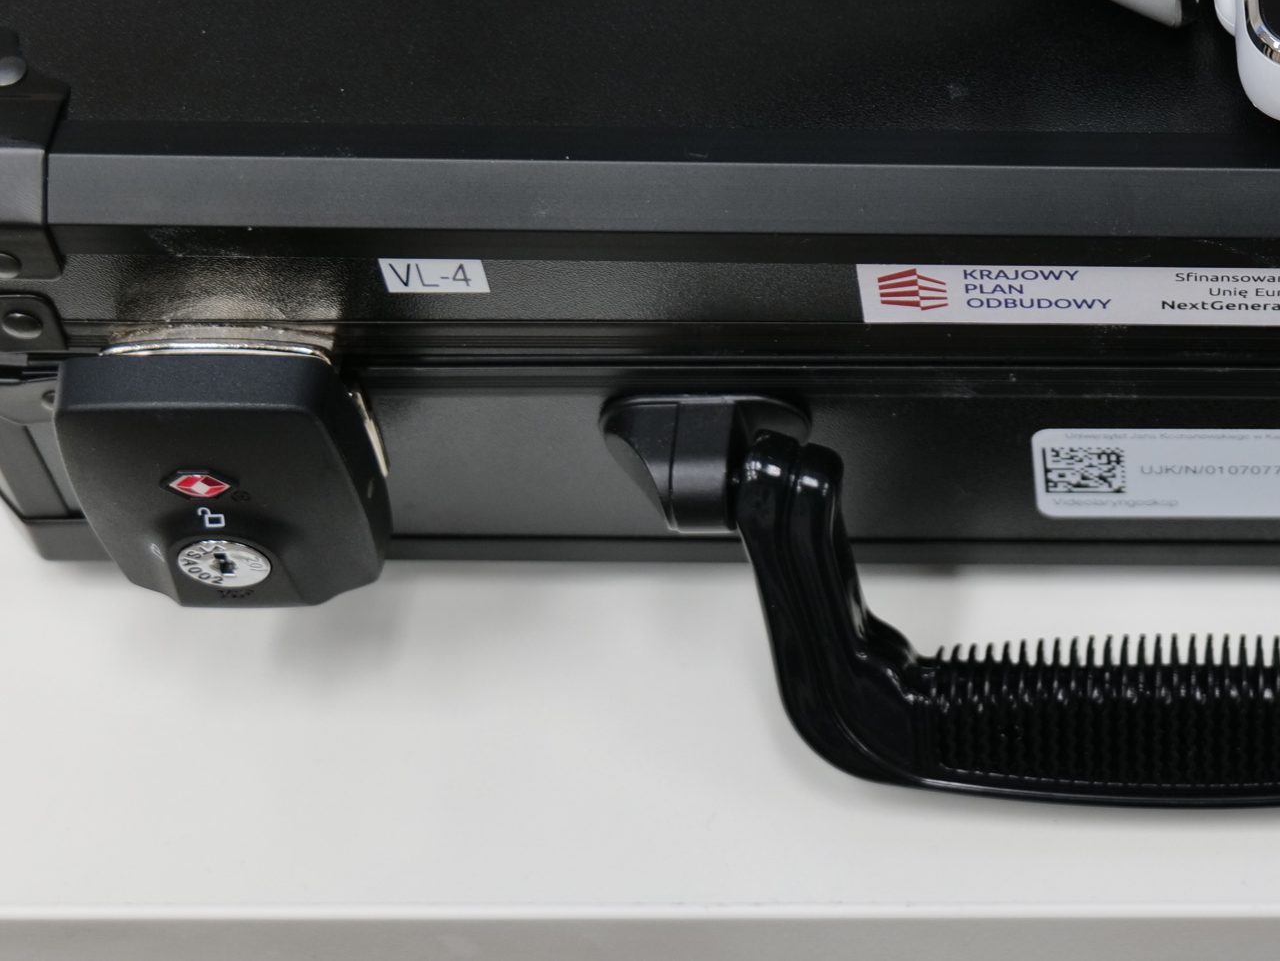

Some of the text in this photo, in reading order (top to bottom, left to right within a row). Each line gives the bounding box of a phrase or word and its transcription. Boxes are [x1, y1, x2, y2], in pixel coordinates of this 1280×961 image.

[388, 263, 472, 287] VL-4
[963, 269, 1079, 281] KRAJOWY
[965, 284, 1024, 294] PLAN
[1208, 288, 1249, 299] Unię
[966, 298, 1112, 309] ODBUDOWY
